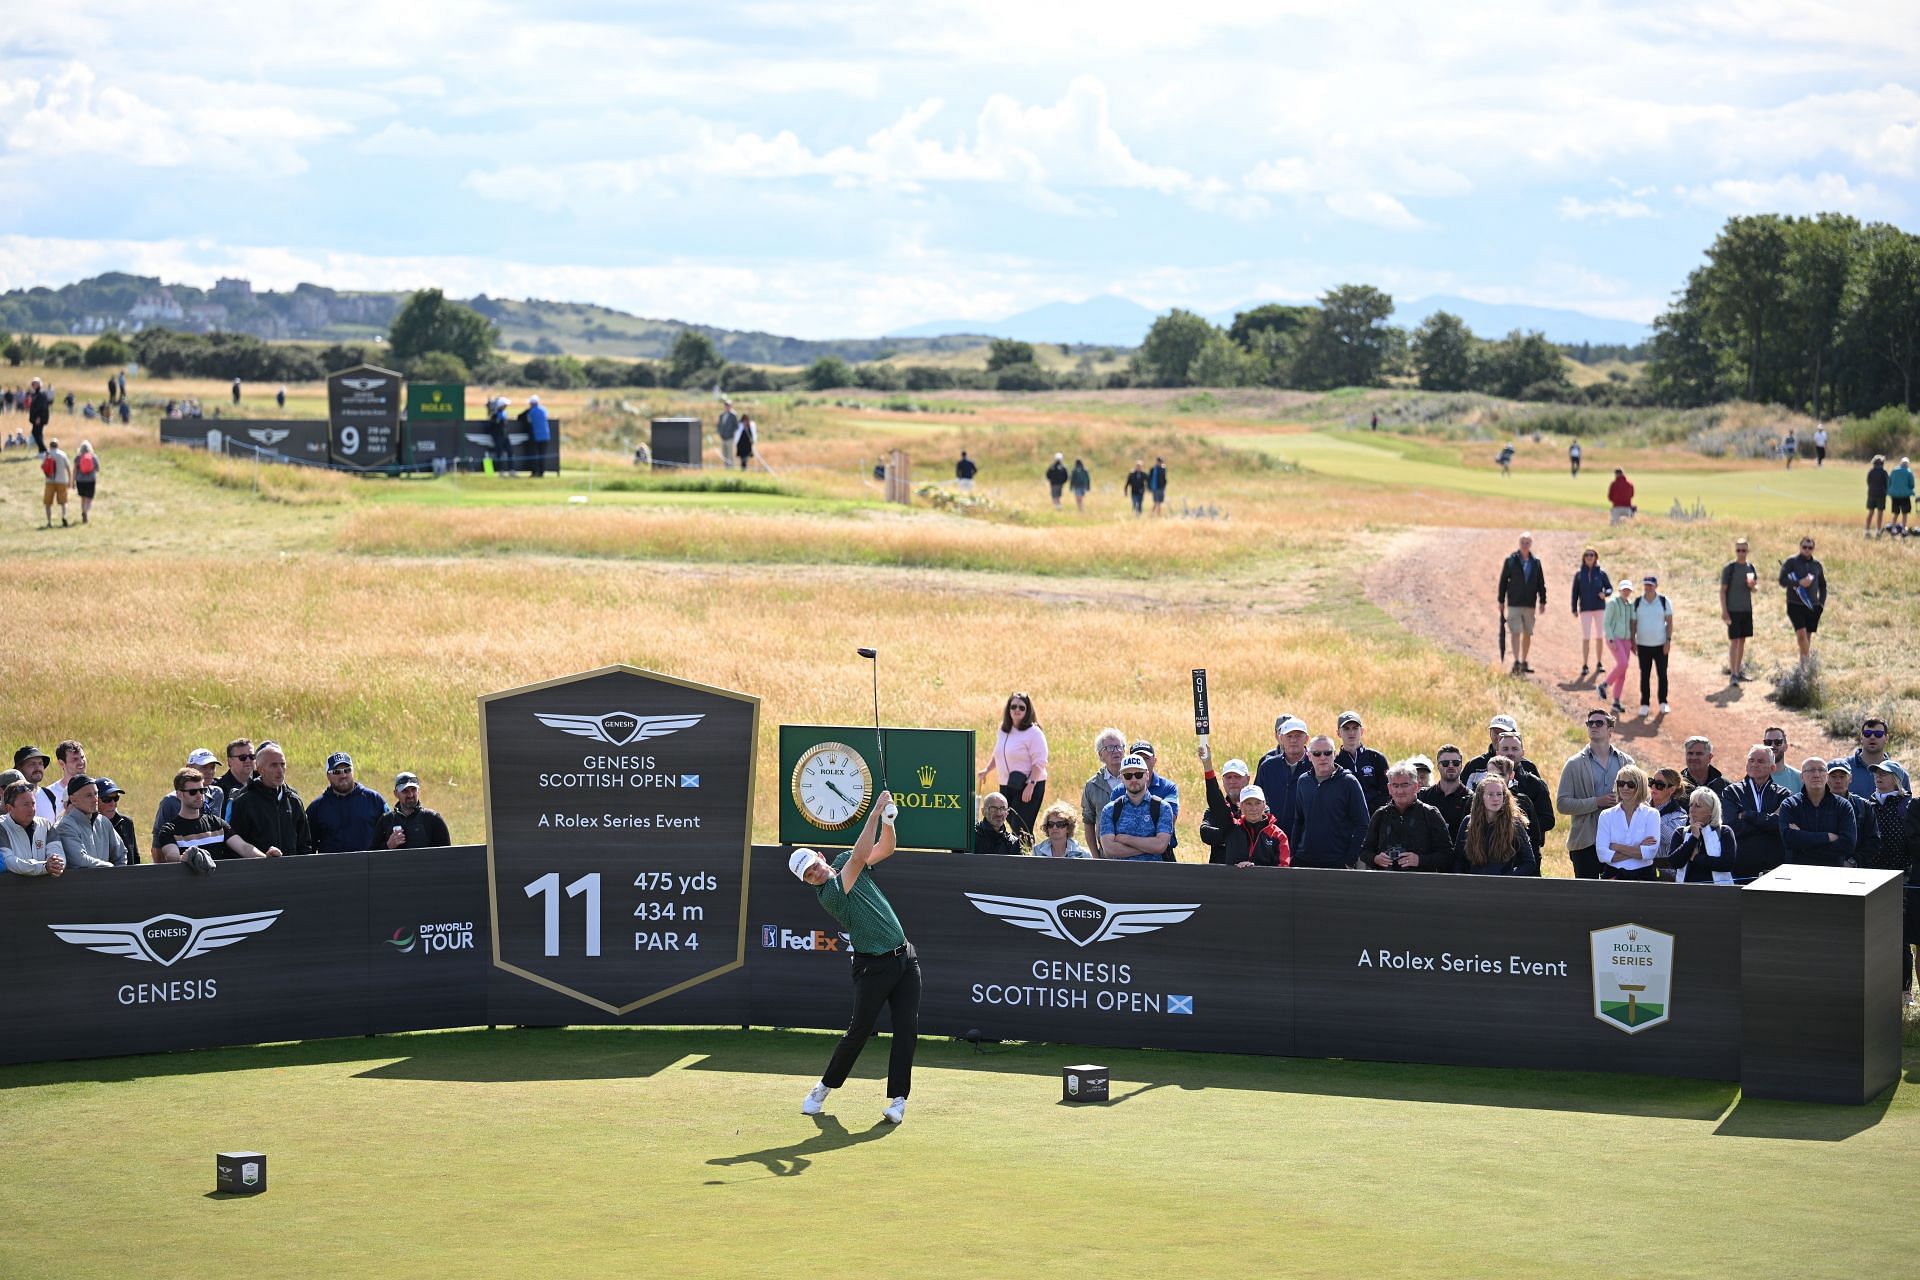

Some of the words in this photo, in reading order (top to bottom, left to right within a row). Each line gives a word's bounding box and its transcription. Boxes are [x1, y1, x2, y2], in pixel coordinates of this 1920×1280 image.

[421, 403, 453, 412] ROLEX
[341, 426, 360, 455] 9
[1196, 677, 1204, 716] QUIET
[604, 720, 635, 729] GENESIS
[583, 755, 656, 770] GENESIS
[1123, 757, 1142, 767] LACC
[539, 773, 623, 788] SCOTTISH
[630, 774, 676, 788] OPEN
[892, 793, 961, 809] ROLEX
[537, 813, 550, 828] A
[555, 813, 599, 828] Rolex
[602, 813, 651, 828] Series
[656, 814, 702, 828] Event
[633, 872, 673, 891] 475
[678, 871, 717, 895] yds
[523, 872, 601, 957] 11
[633, 902, 676, 921] 434
[682, 905, 703, 921] m
[1061, 908, 1102, 920] GENESIS
[147, 928, 188, 939] GENESIS
[419, 924, 435, 934] DP
[435, 921, 474, 933] WORLD
[421, 932, 475, 955] TOUR
[635, 931, 680, 951] PAR
[684, 932, 699, 951] 4
[780, 928, 839, 952] FedEx
[1613, 943, 1651, 953] ROLEX
[1357, 948, 1373, 968] A
[1379, 949, 1435, 971] Rolex
[1440, 952, 1503, 974] Series
[1509, 955, 1568, 977] Event
[1611, 955, 1653, 967] SERIES
[1032, 959, 1131, 985] GENESIS
[118, 978, 217, 1005] GENESIS
[971, 983, 1087, 1009] SCOTTISH
[1096, 990, 1160, 1014] OPEN
